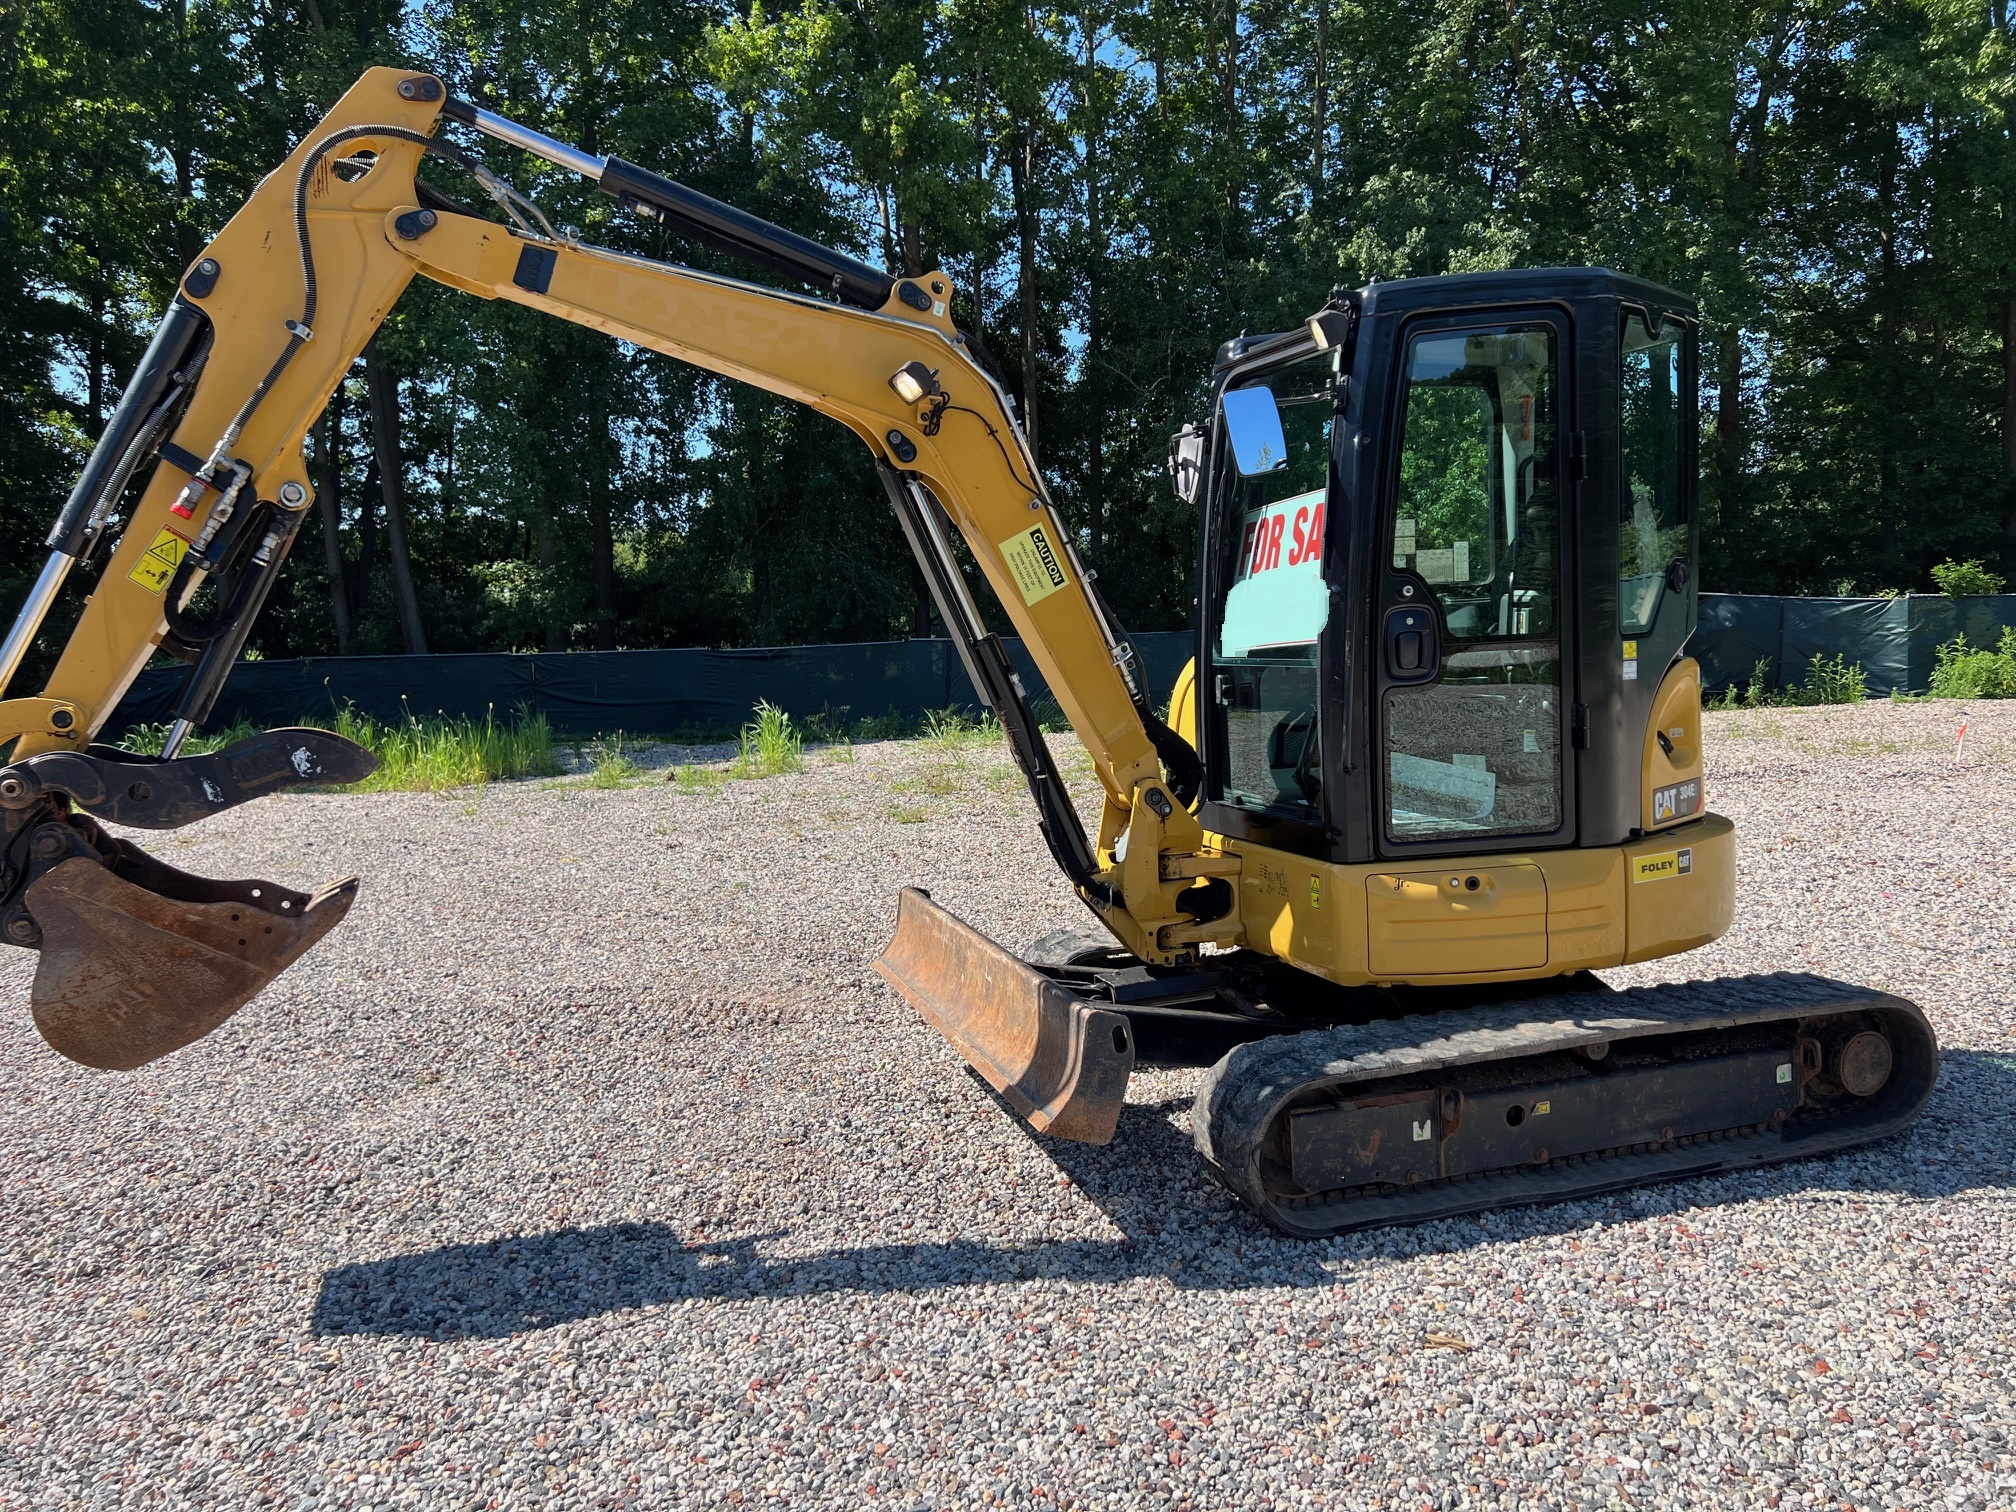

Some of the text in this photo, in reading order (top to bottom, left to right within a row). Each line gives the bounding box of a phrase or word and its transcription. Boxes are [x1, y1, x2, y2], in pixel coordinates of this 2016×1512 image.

[1032, 533, 1061, 582] CAUTION
[1238, 513, 1285, 575] FOR
[1016, 551, 1025, 566] WITHIN
[1025, 570, 1033, 580] FEET
[1018, 540, 1030, 559] OPERATE
[1032, 568, 1045, 590] EQUIPMENT
[1030, 549, 1043, 570] UNLAWFUL
[1014, 562, 1025, 580] VOLTAGE
[1023, 580, 1031, 592] LINES
[1655, 789, 1677, 820] CAT
[1641, 855, 1690, 873] FOLEY CAT
[1394, 878, 1409, 891] Jr.
